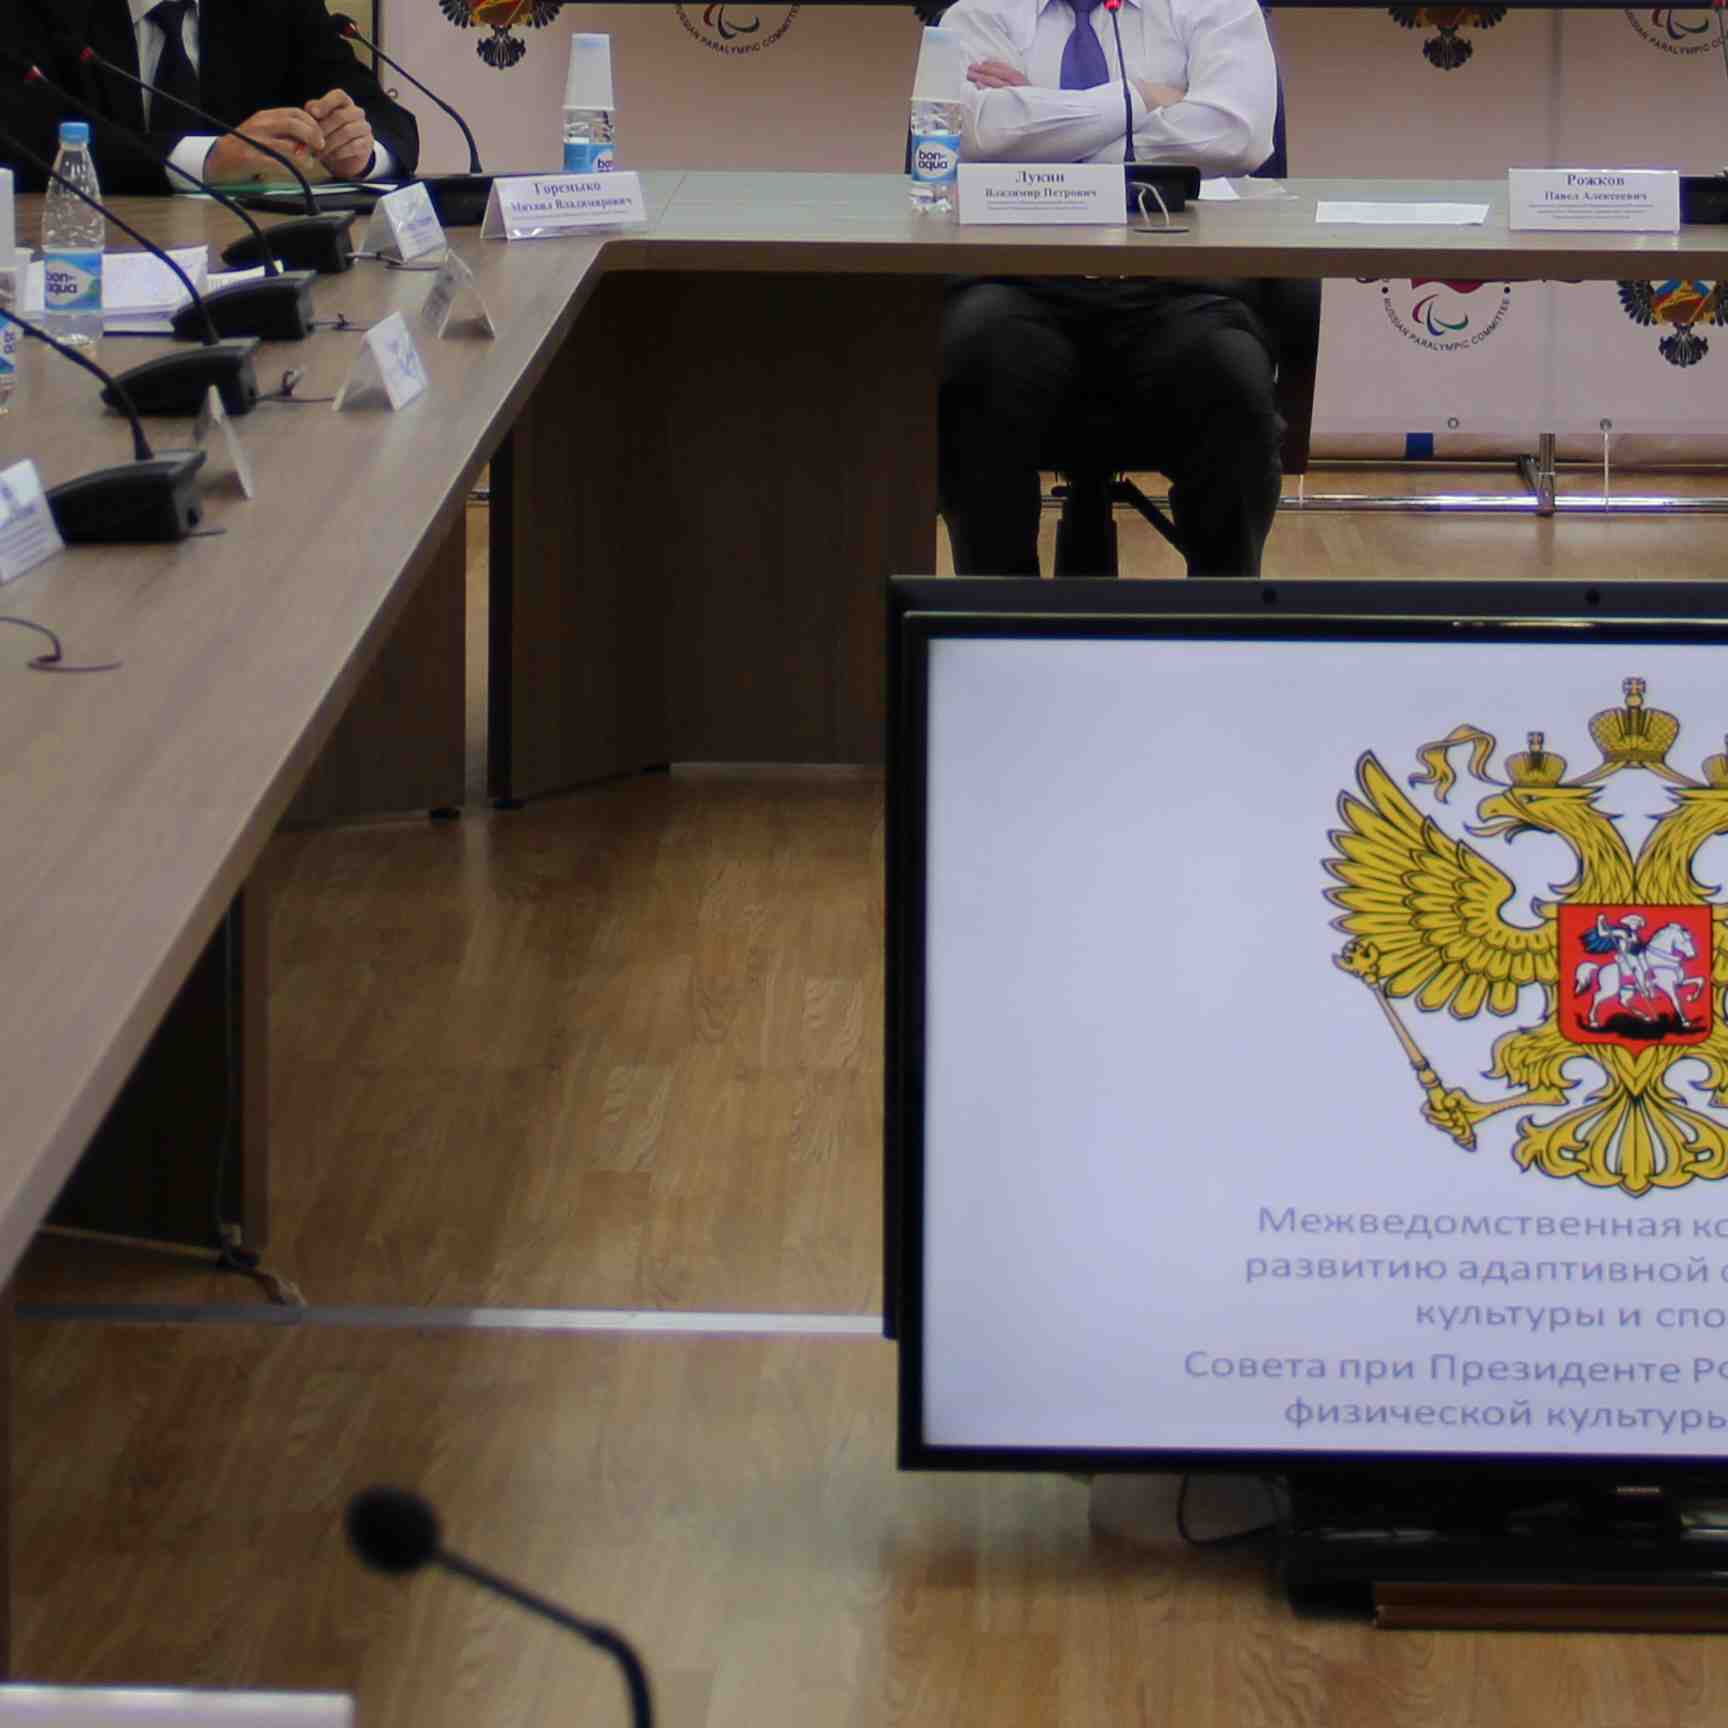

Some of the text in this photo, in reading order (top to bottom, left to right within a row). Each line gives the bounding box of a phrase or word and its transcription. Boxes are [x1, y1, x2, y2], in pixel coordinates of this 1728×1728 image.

[918, 159, 948, 170] aqua
[1015, 170, 1065, 185] Лукин
[984, 187, 1097, 198] Владимир Петрович
[1567, 174, 1625, 187] Рожков
[1544, 191, 1648, 201] Павел Алексеевич
[1408, 332, 1470, 352] PARALYMPIC
[1471, 294, 1511, 346] COMMITTEE
[1258, 1206, 1680, 1240] Межведомственная
[1244, 1255, 1447, 1283] развитию
[1458, 1256, 1709, 1286] адаптивной
[1415, 1303, 1605, 1333] культуры
[1619, 1307, 1641, 1328] и
[1184, 1350, 1327, 1379] Совета
[1339, 1357, 1415, 1386] при
[1429, 1353, 1681, 1387] Президенте
[1283, 1397, 1532, 1429] физической
